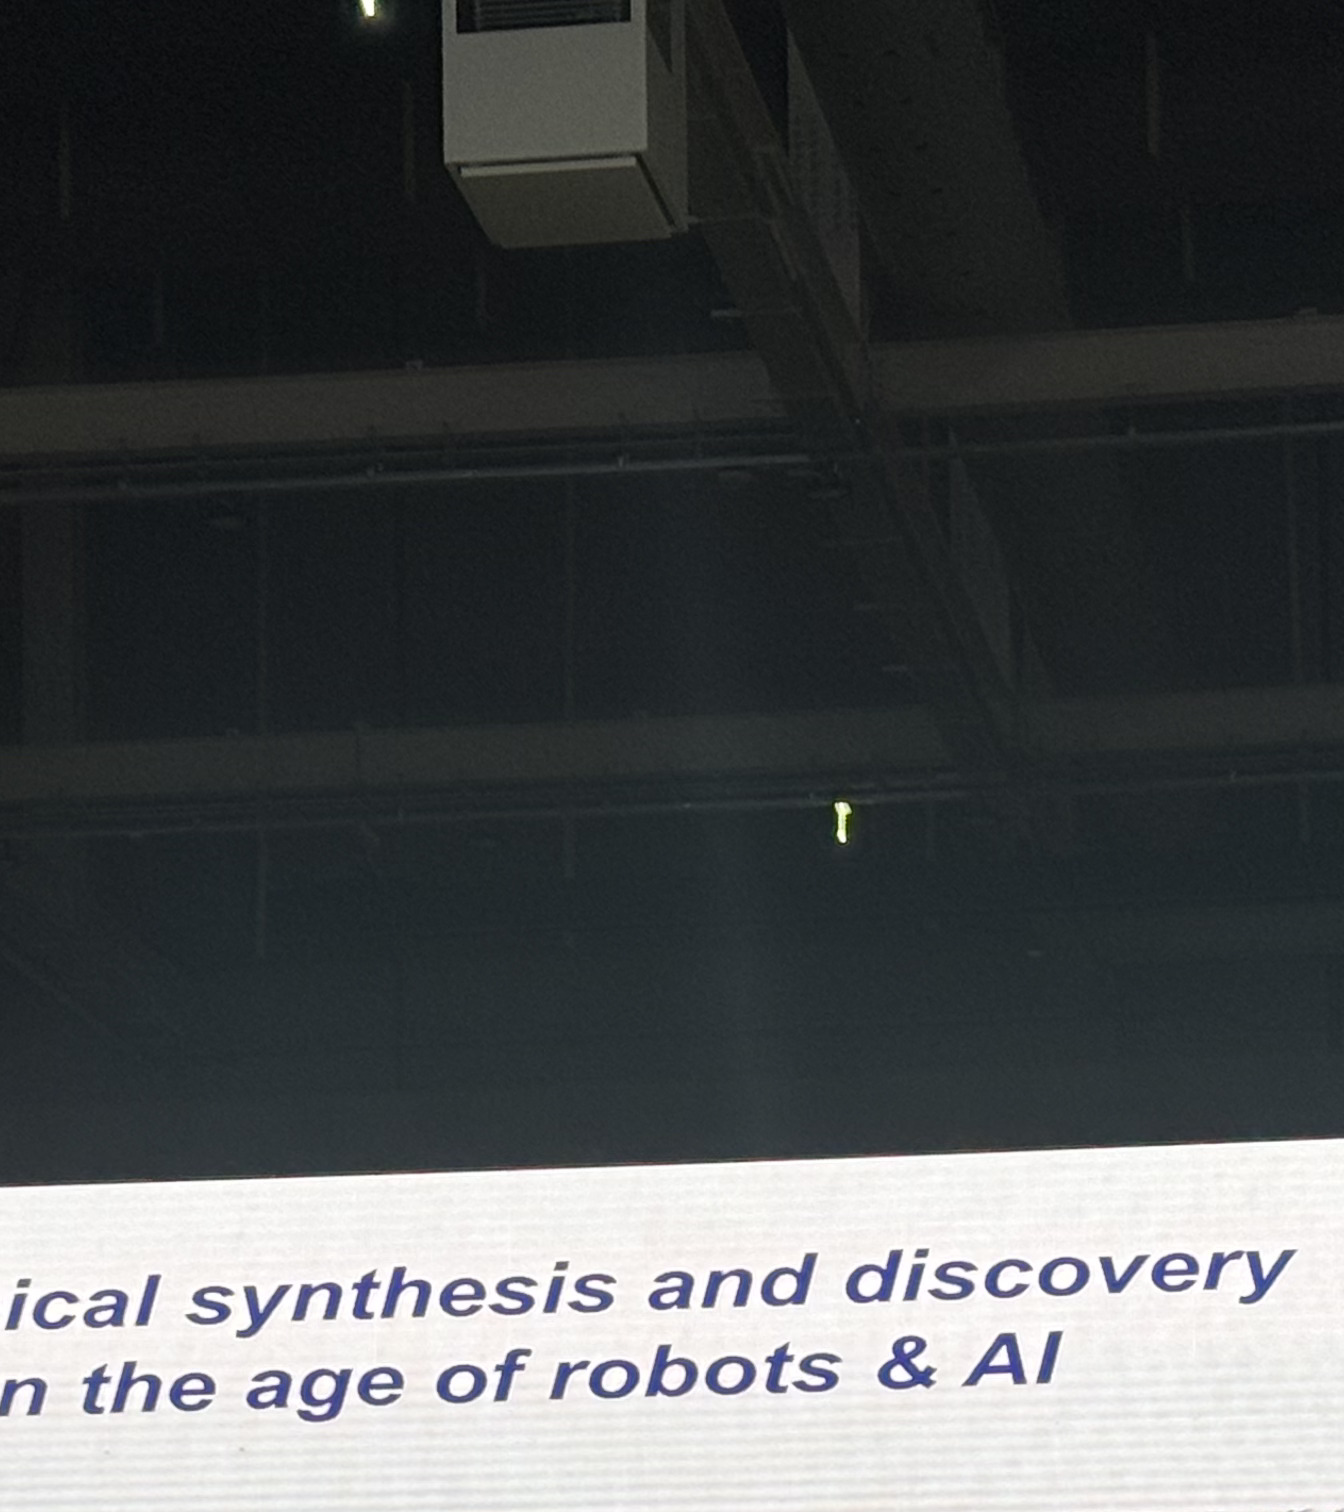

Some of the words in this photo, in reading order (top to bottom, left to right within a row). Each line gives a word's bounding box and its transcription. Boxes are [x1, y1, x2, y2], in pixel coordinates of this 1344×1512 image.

[185, 1261, 617, 1339] synthesis
[648, 1252, 818, 1311] and
[845, 1248, 1296, 1305] discovery
[82, 1361, 216, 1415] the
[246, 1366, 404, 1423] age
[436, 1348, 532, 1404] of
[549, 1342, 842, 1400] robots
[877, 1335, 937, 1390] &
[962, 1330, 1063, 1387] AI
